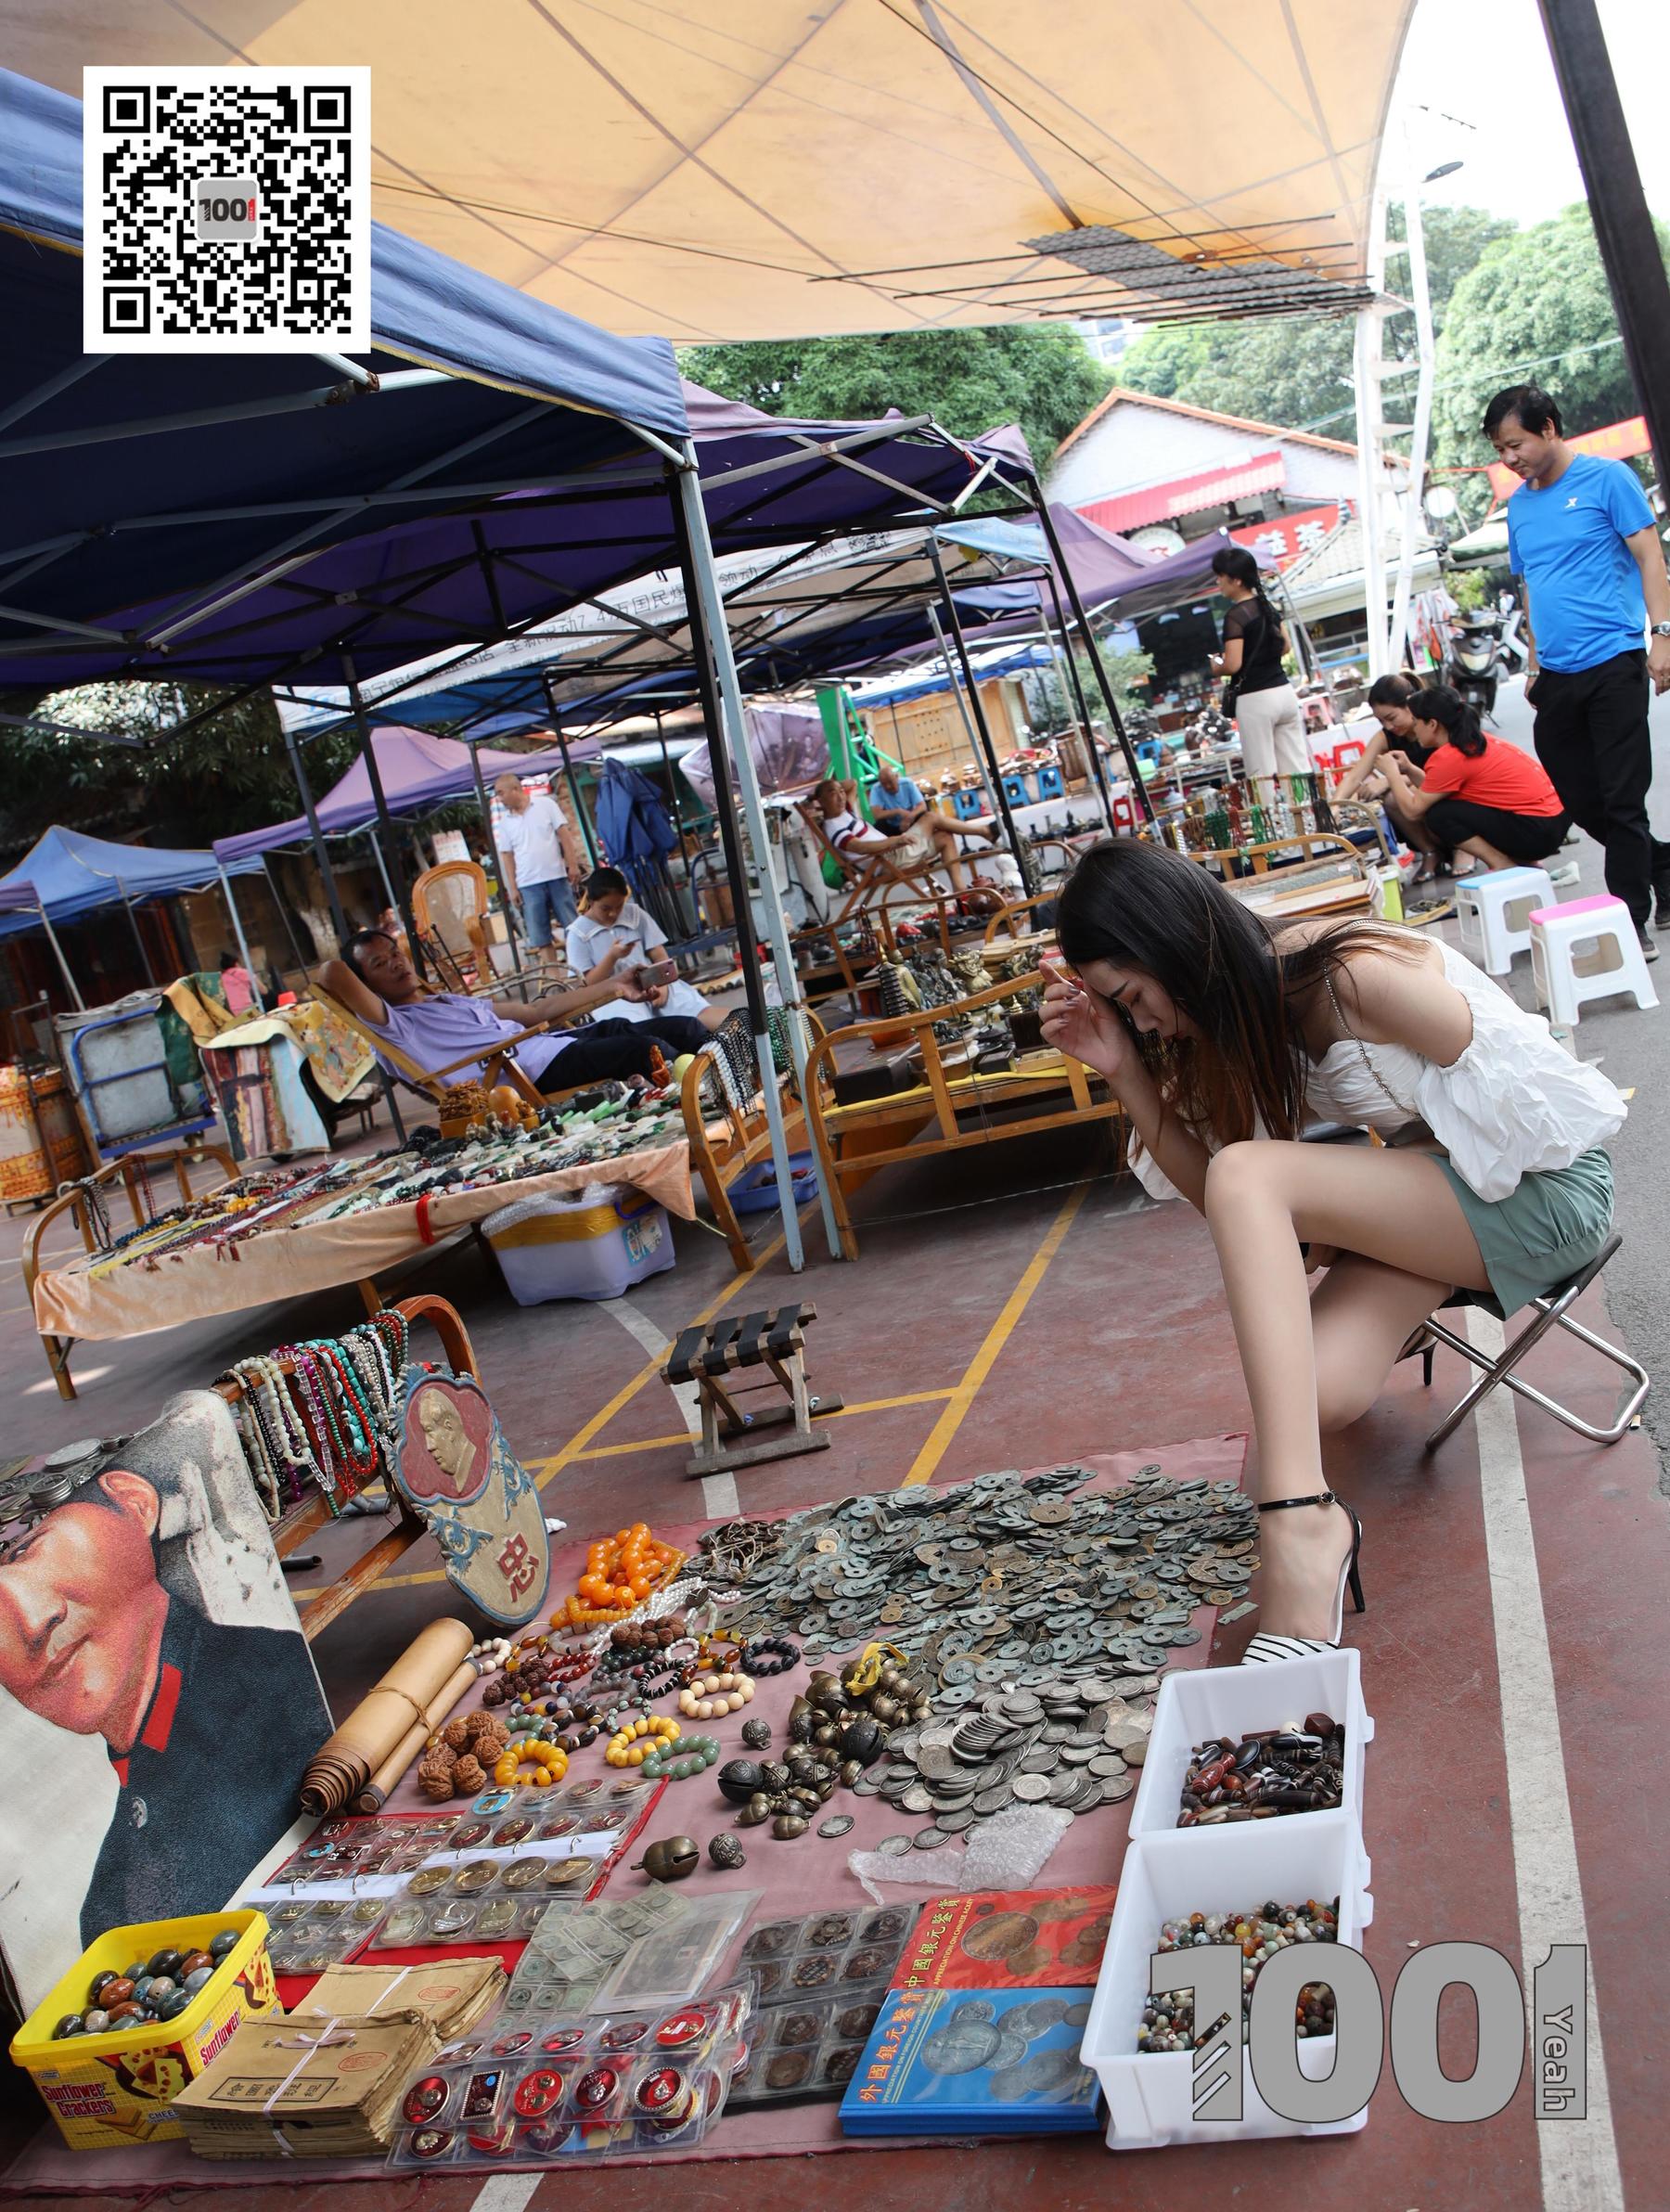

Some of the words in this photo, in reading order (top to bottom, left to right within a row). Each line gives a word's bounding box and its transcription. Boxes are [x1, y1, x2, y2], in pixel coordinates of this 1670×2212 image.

[497, 1532, 540, 1603] 忠
[199, 2010, 241, 2067] Sunflower
[41, 2082, 105, 2102] Sunflower
[56, 2098, 116, 2118] Crackers
